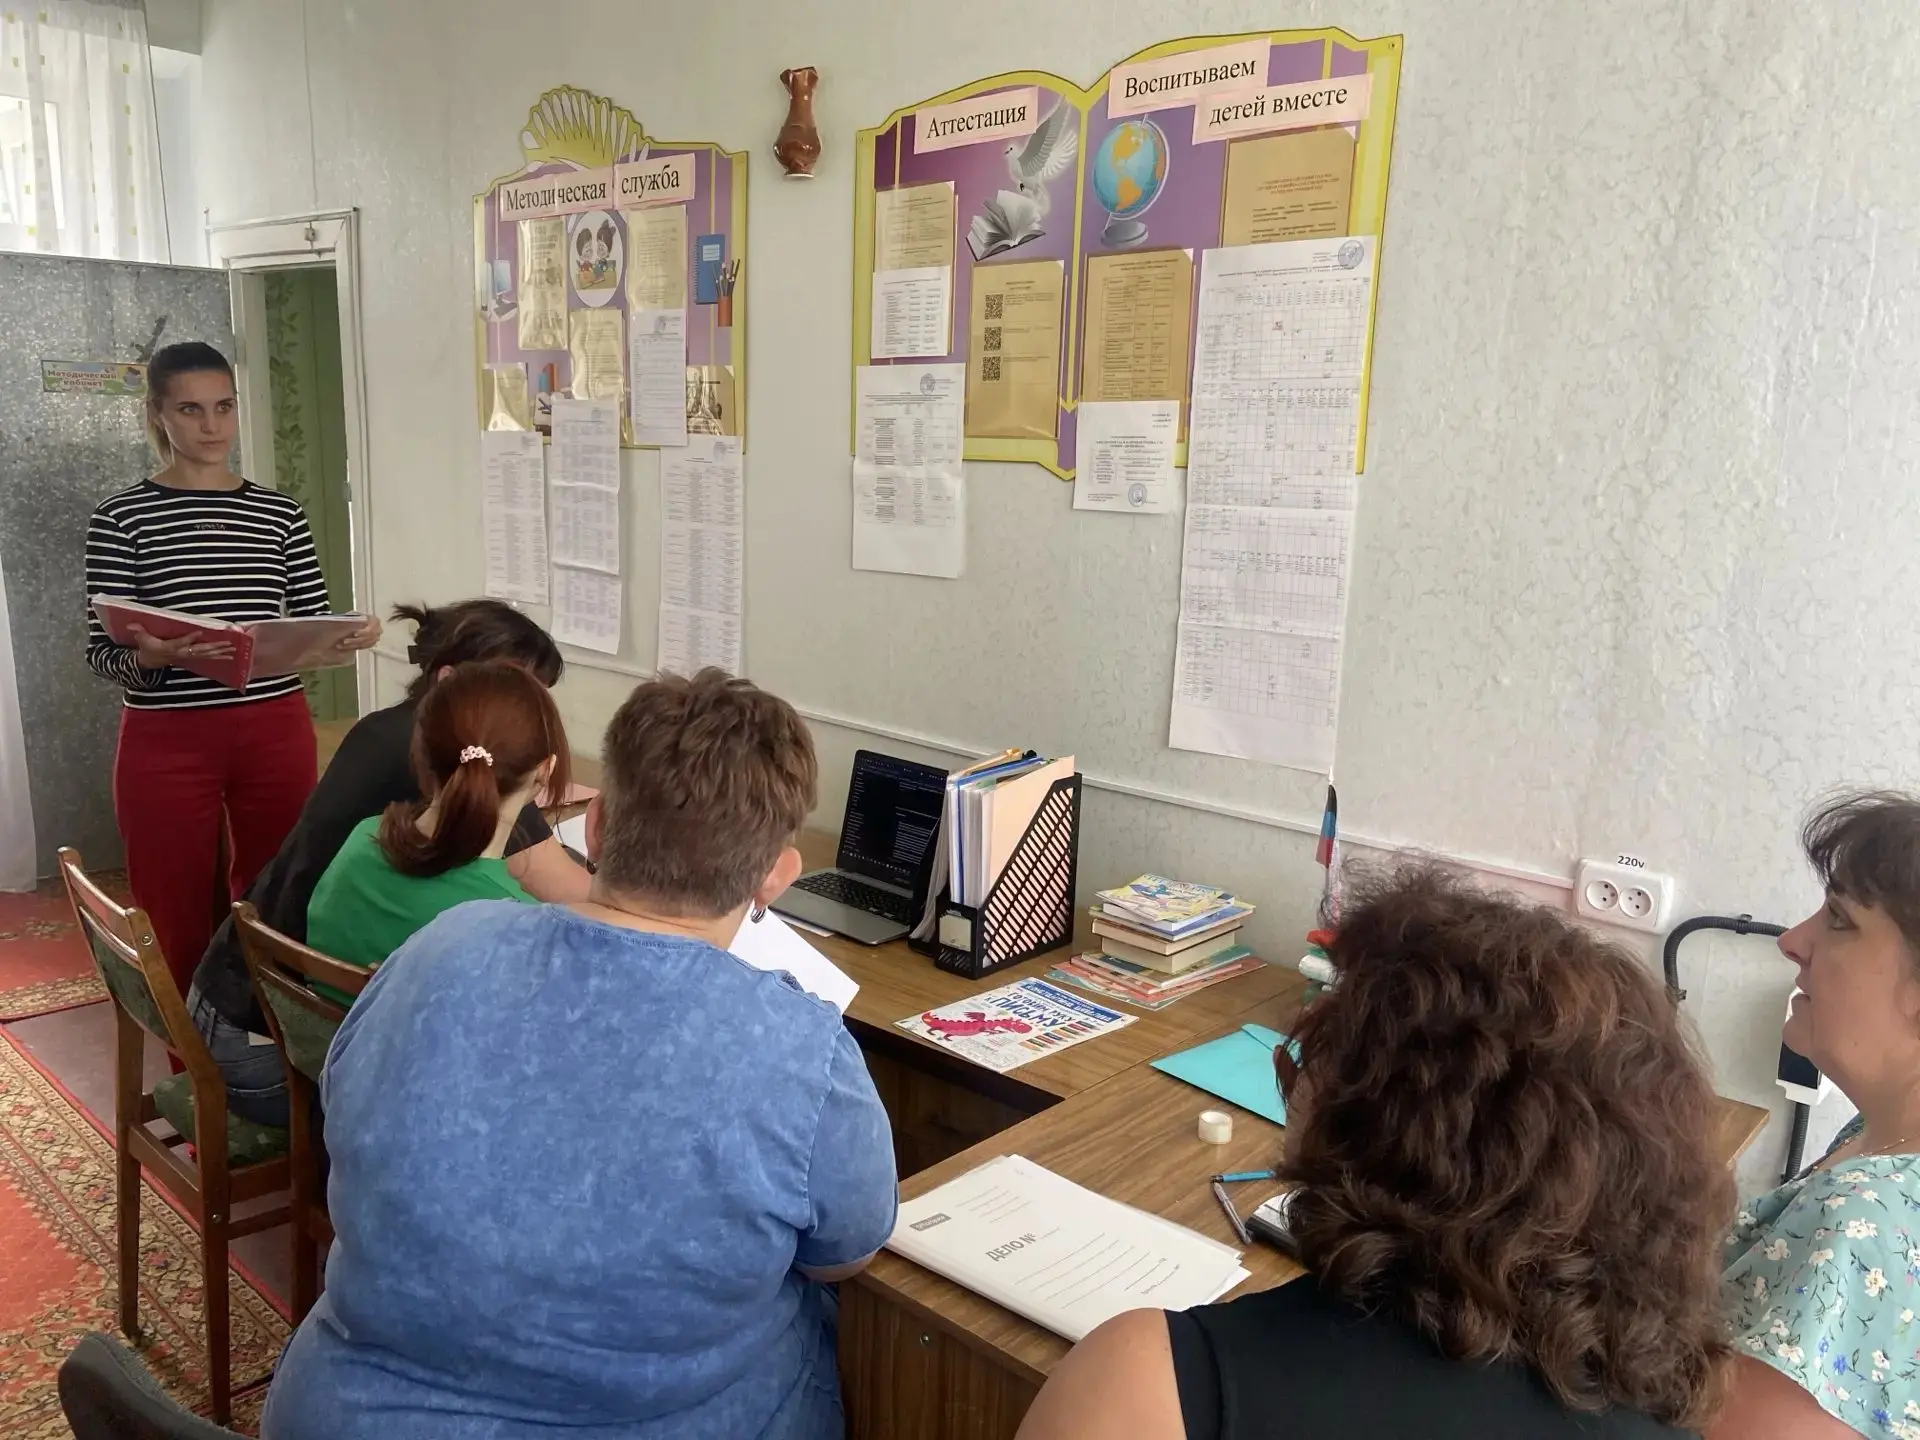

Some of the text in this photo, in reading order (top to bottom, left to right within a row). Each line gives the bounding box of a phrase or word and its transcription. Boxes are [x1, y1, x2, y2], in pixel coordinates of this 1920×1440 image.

[1124, 59, 1257, 98] Воспитываем
[926, 105, 1027, 139] Аттестация
[1208, 87, 1348, 127] детей вместе
[506, 164, 680, 212] Методическая служба
[1617, 855, 1645, 868] 220v
[985, 1240, 1025, 1262] ДЕЛО
